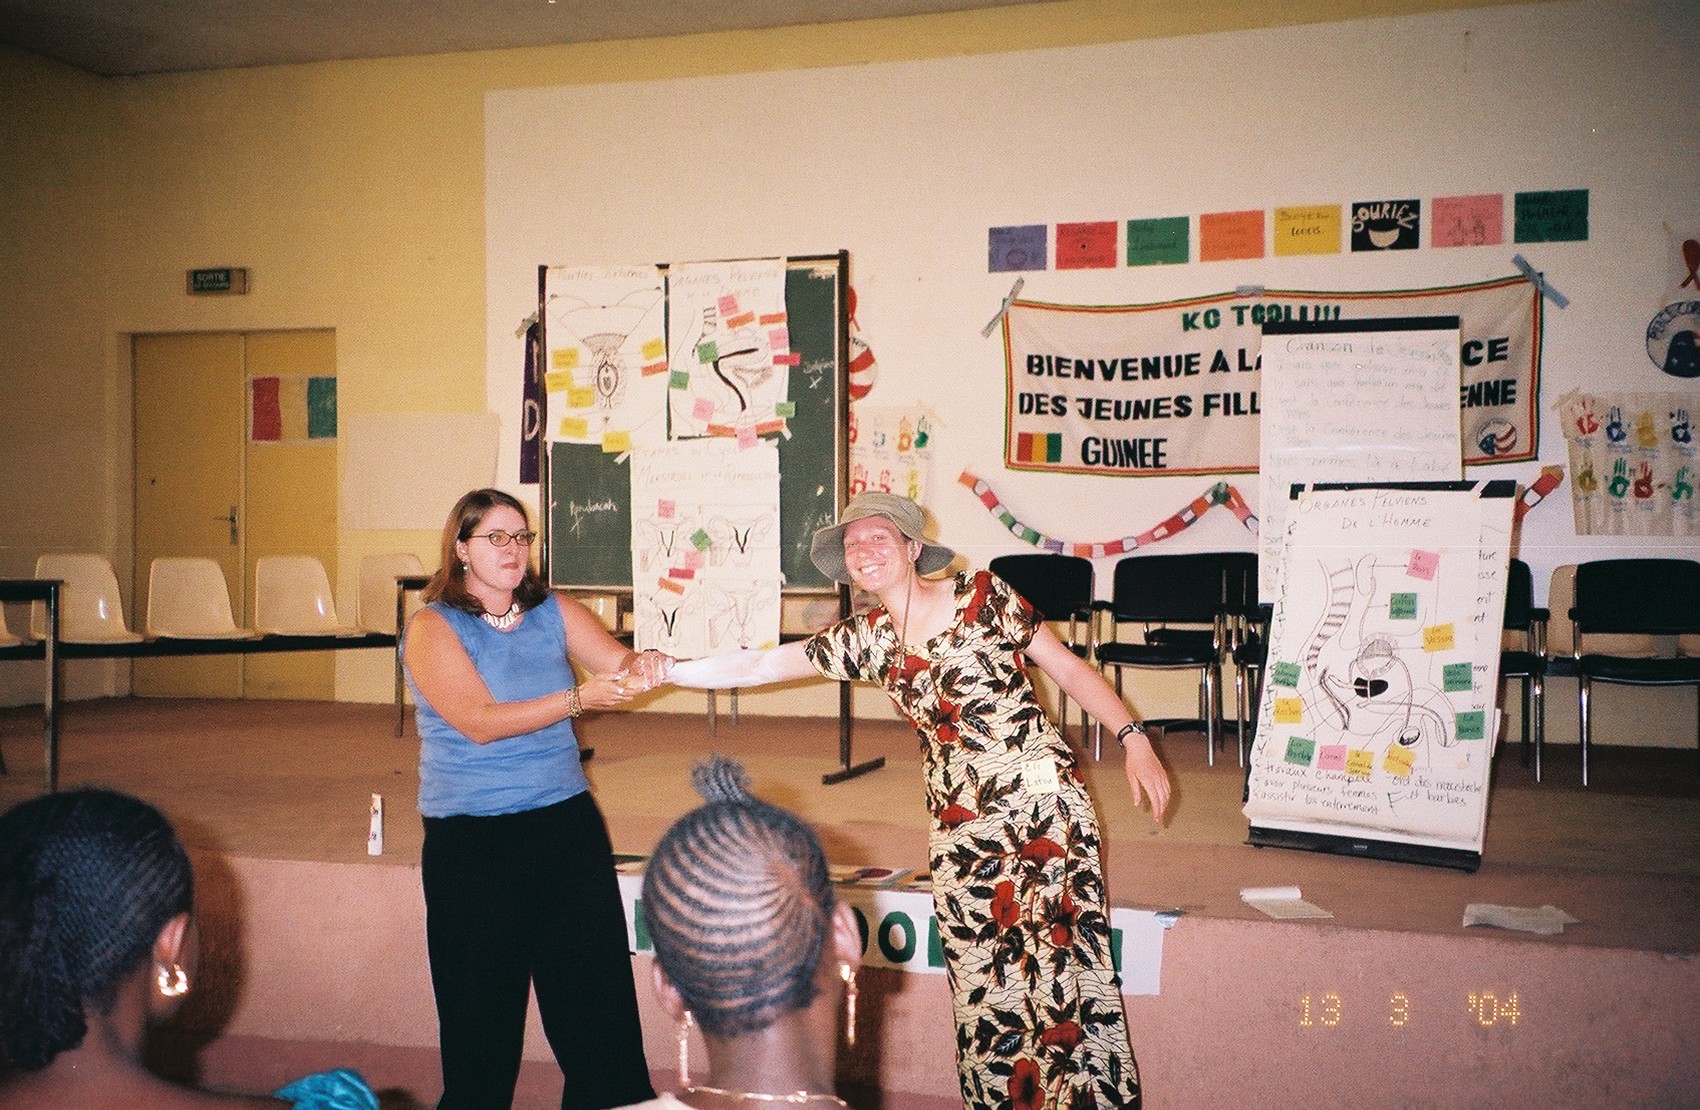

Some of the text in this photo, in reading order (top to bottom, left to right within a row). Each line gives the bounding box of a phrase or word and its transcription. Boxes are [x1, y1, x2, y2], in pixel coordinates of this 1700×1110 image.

[1352, 202, 1418, 233] SOURIEZ
[1026, 352, 1201, 381] BIENVENUE
[1018, 392, 1067, 416] DES
[1075, 394, 1193, 421] JEUNES
[1081, 435, 1168, 469] GUINEE
[1299, 494, 1367, 514] ORGANES
